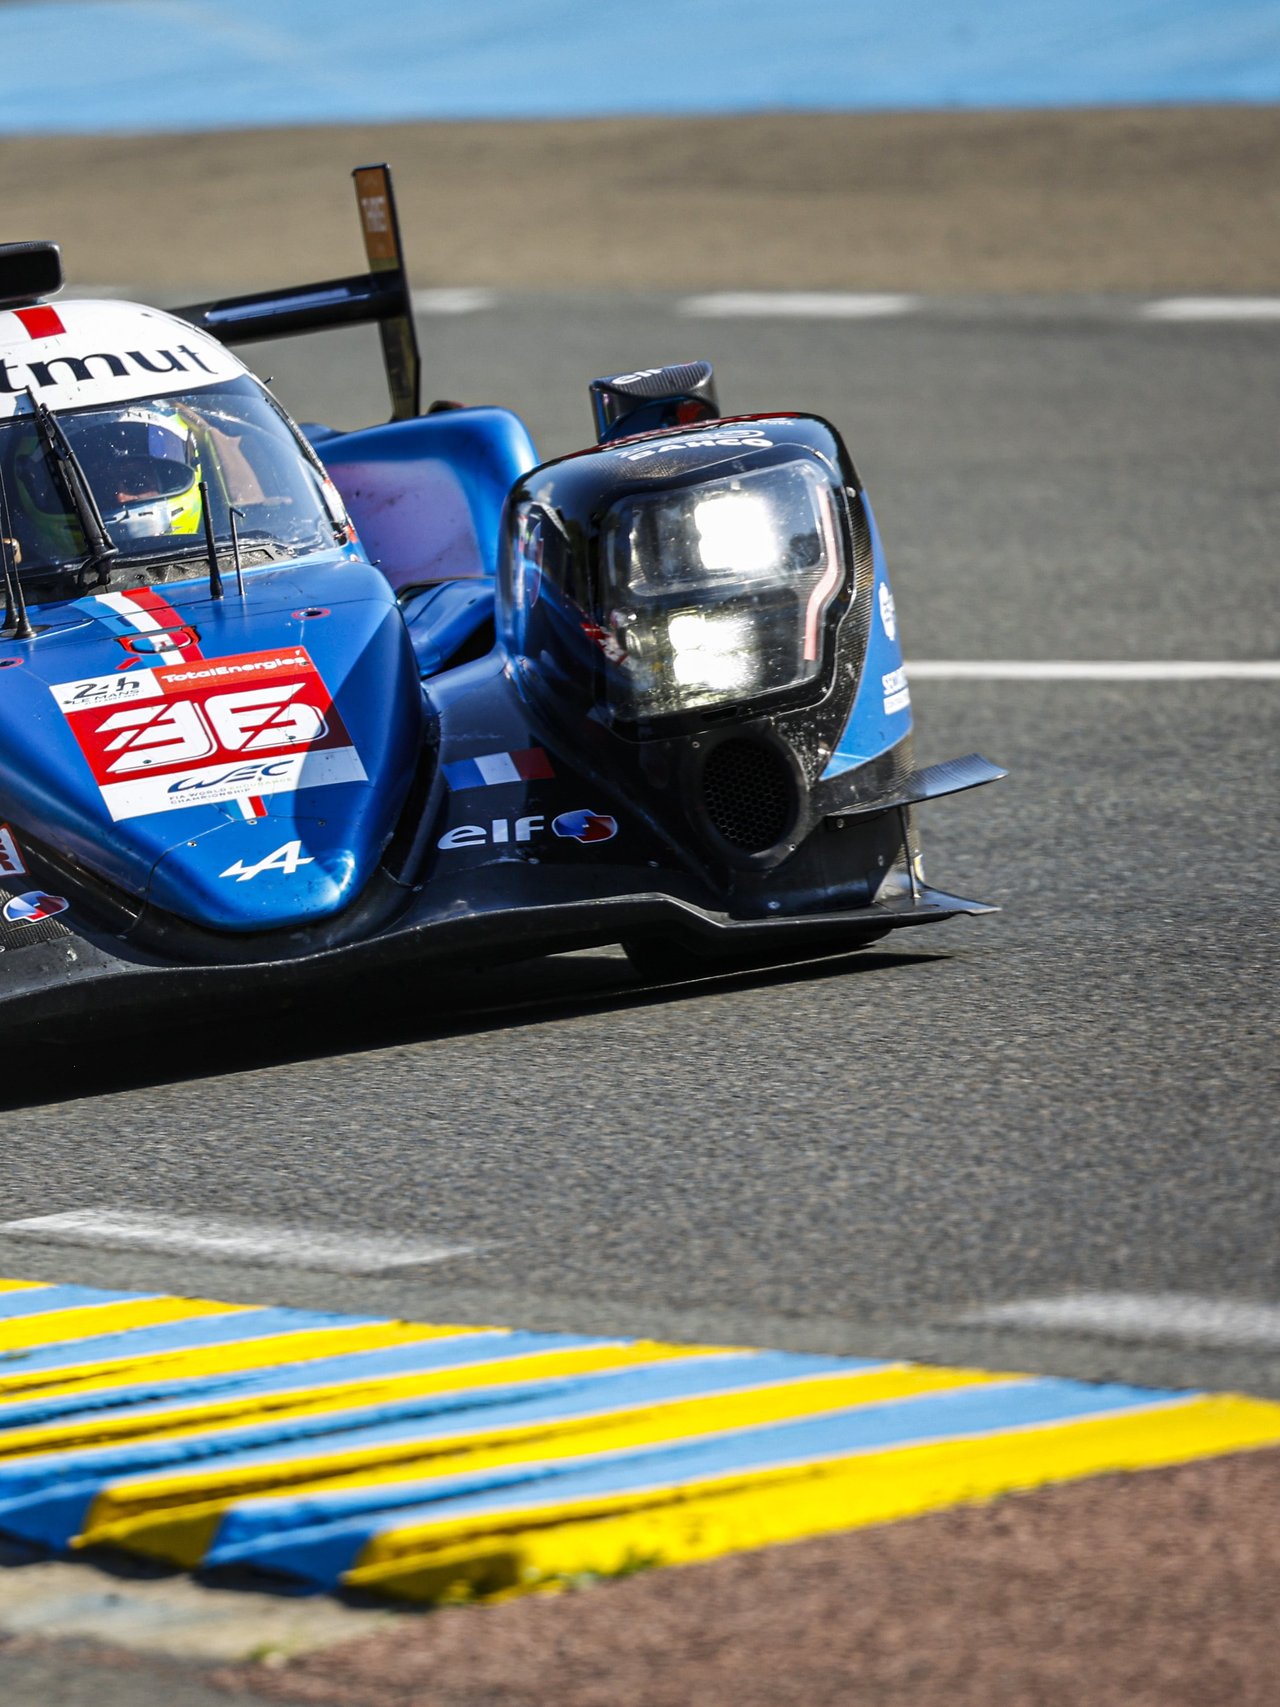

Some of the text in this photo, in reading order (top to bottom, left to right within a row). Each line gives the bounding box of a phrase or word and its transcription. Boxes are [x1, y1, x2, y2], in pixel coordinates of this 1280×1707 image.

[626, 438, 774, 461] BAHCO
[161, 656, 307, 683] TotalEnergies
[94, 682, 329, 774] 36
[167, 760, 295, 793] WEC
[437, 815, 545, 850] elf
